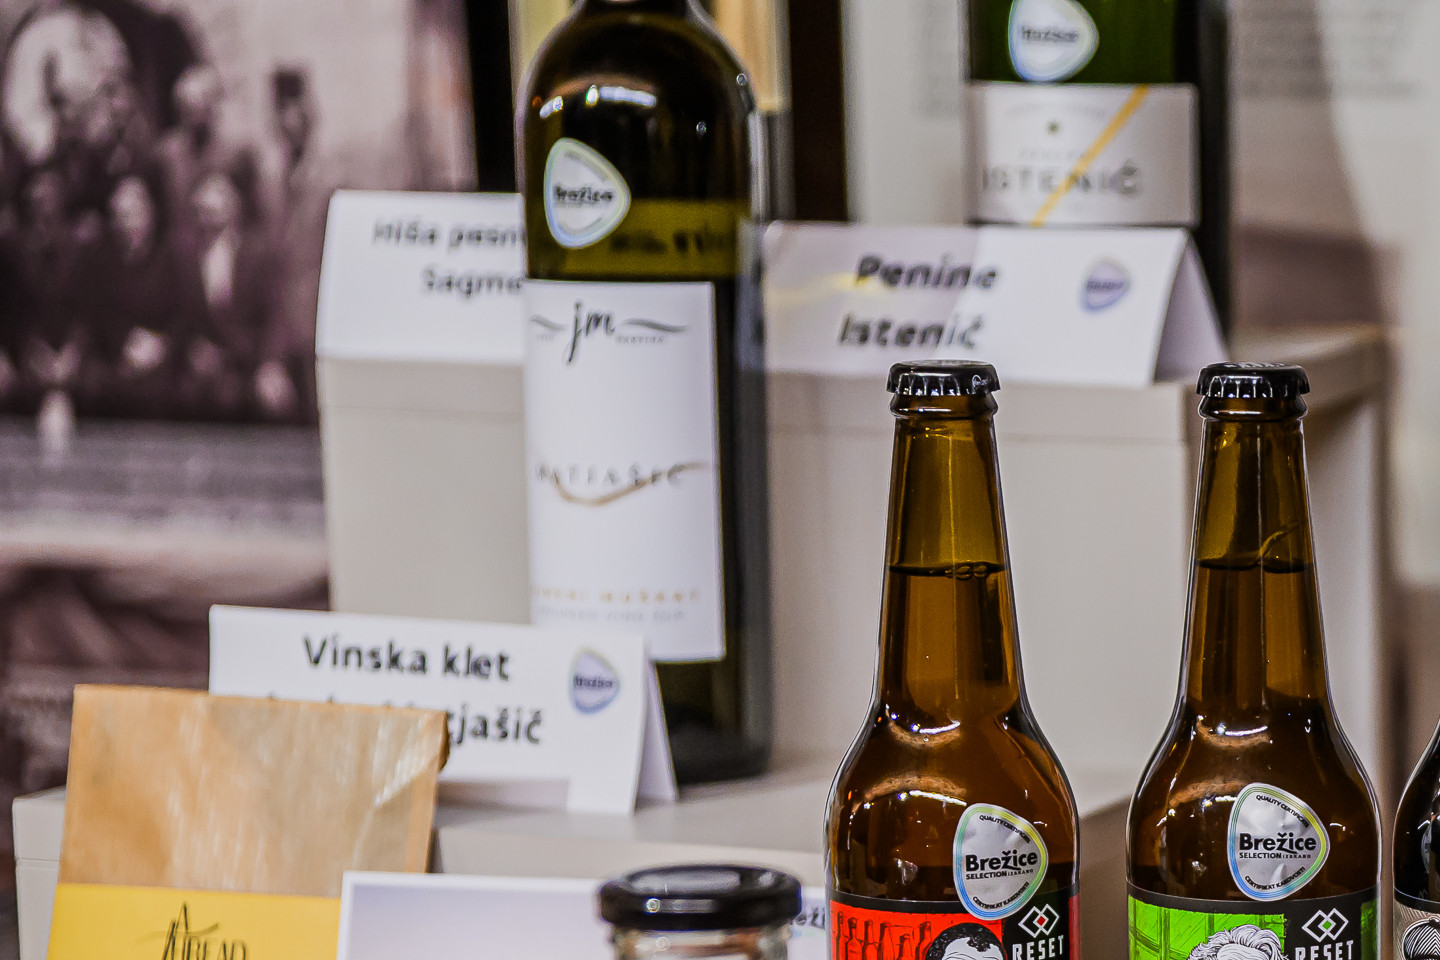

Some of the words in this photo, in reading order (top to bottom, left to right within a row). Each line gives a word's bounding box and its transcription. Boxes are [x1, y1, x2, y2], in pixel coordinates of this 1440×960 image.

[854, 253, 997, 289] Penine
[304, 635, 428, 675] Vinska
[443, 641, 510, 681] klet
[1239, 832, 1317, 854] Brežice
[965, 849, 1038, 871] Brežice
[966, 871, 1007, 880] SELECTION
